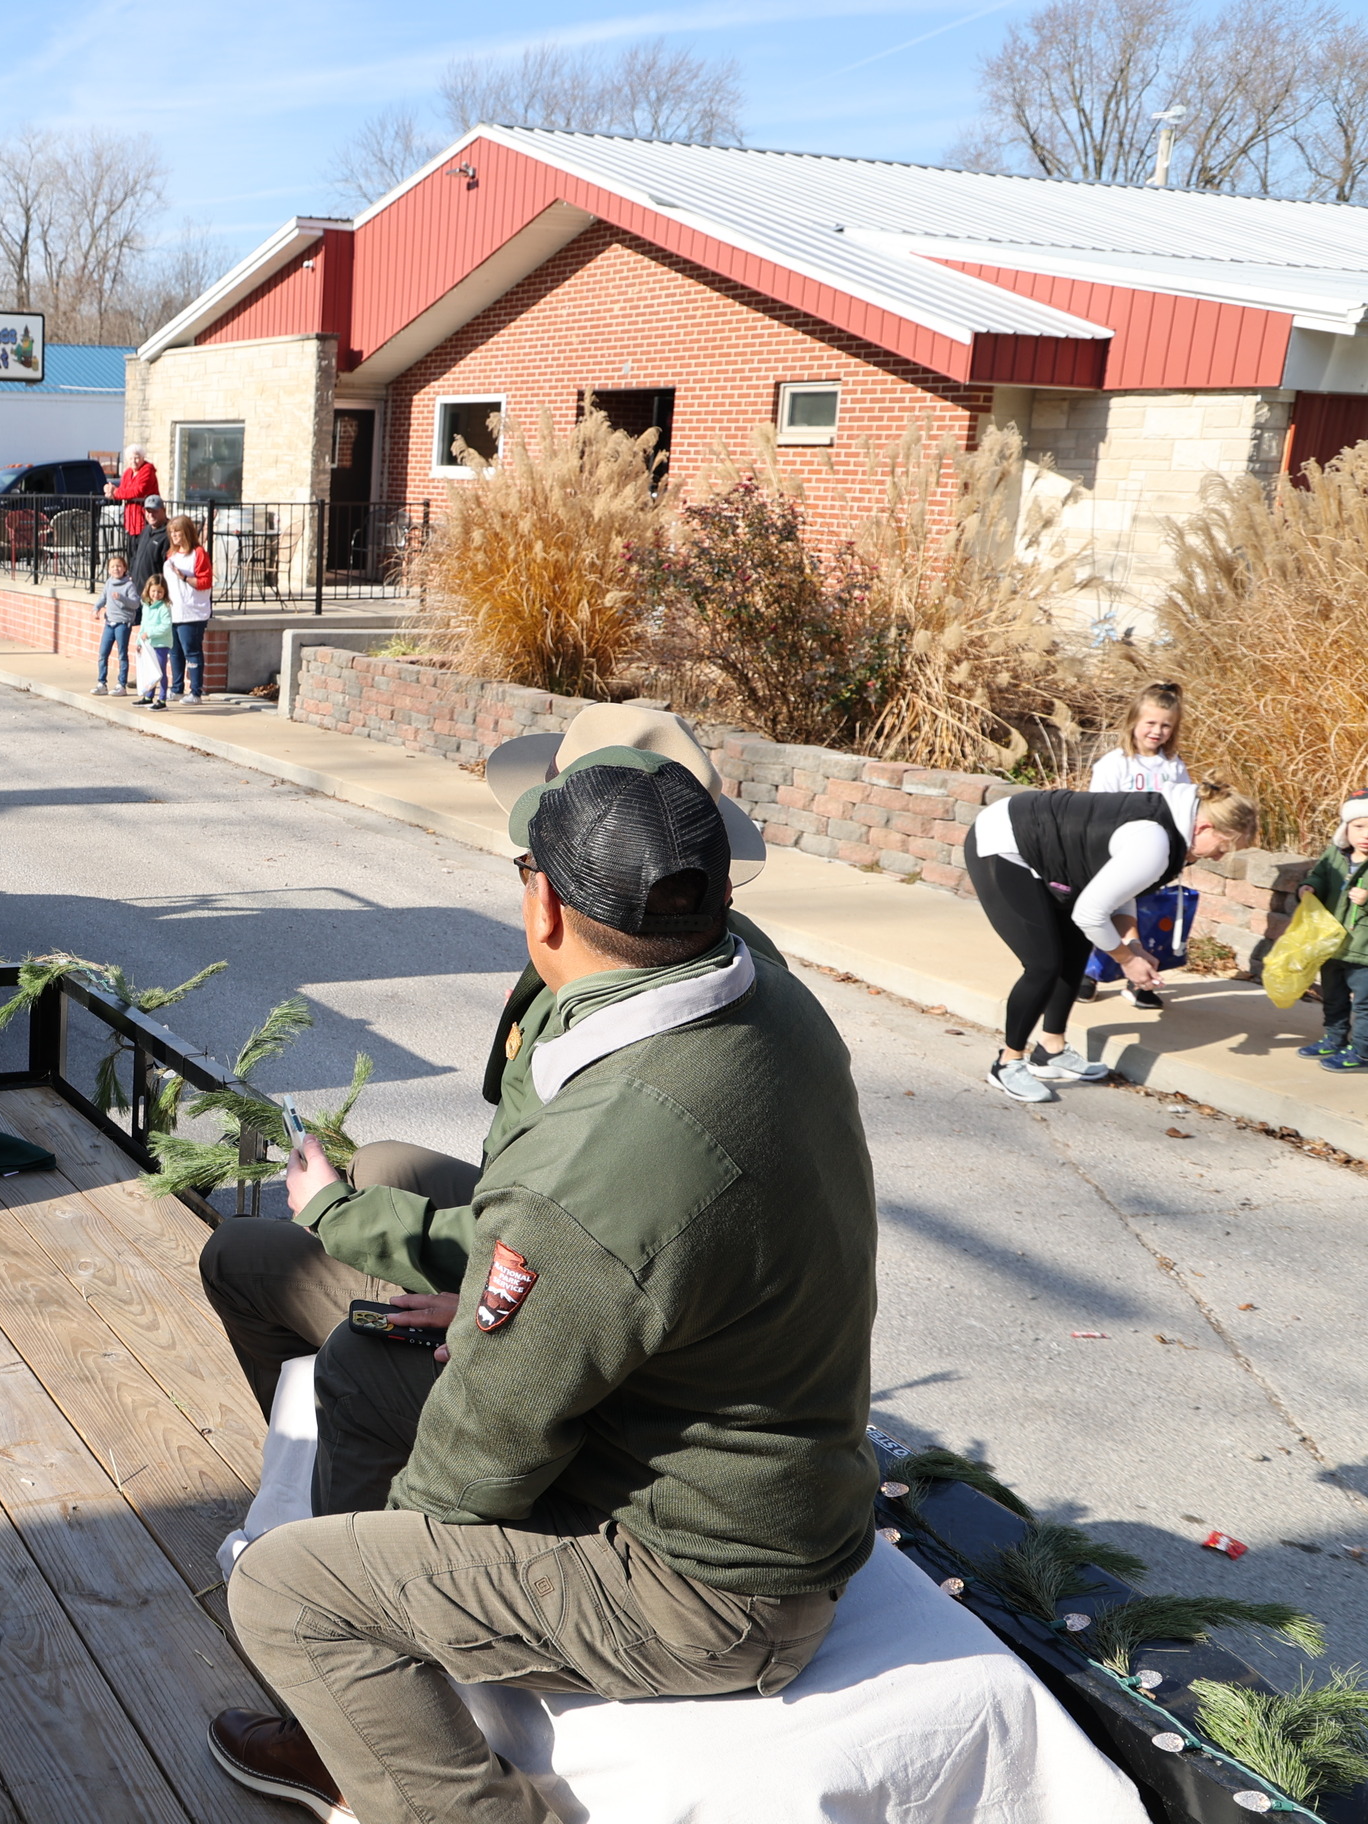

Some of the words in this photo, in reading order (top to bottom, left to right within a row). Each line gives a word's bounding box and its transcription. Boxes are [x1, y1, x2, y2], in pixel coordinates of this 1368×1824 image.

[494, 1261, 531, 1282] NATIONAL
[499, 1273, 520, 1285] PARK
[493, 1276, 524, 1293] SERVICE
